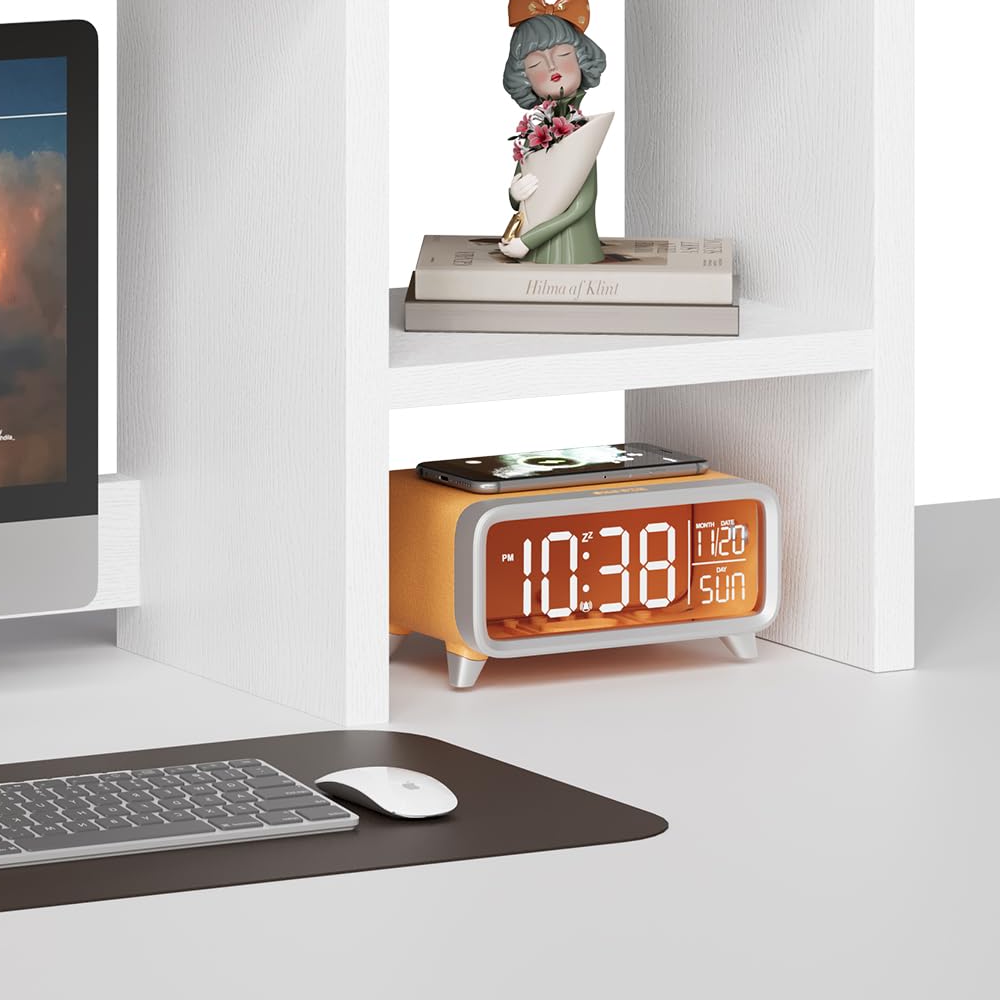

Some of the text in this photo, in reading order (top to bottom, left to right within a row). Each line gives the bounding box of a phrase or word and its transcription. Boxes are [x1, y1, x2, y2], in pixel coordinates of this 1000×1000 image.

[526, 279, 620, 301] Hilma af Klint
[720, 519, 735, 527] DATE
[698, 524, 745, 557] 11/20
[502, 553, 514, 562] PM
[523, 522, 676, 619] 10:38
